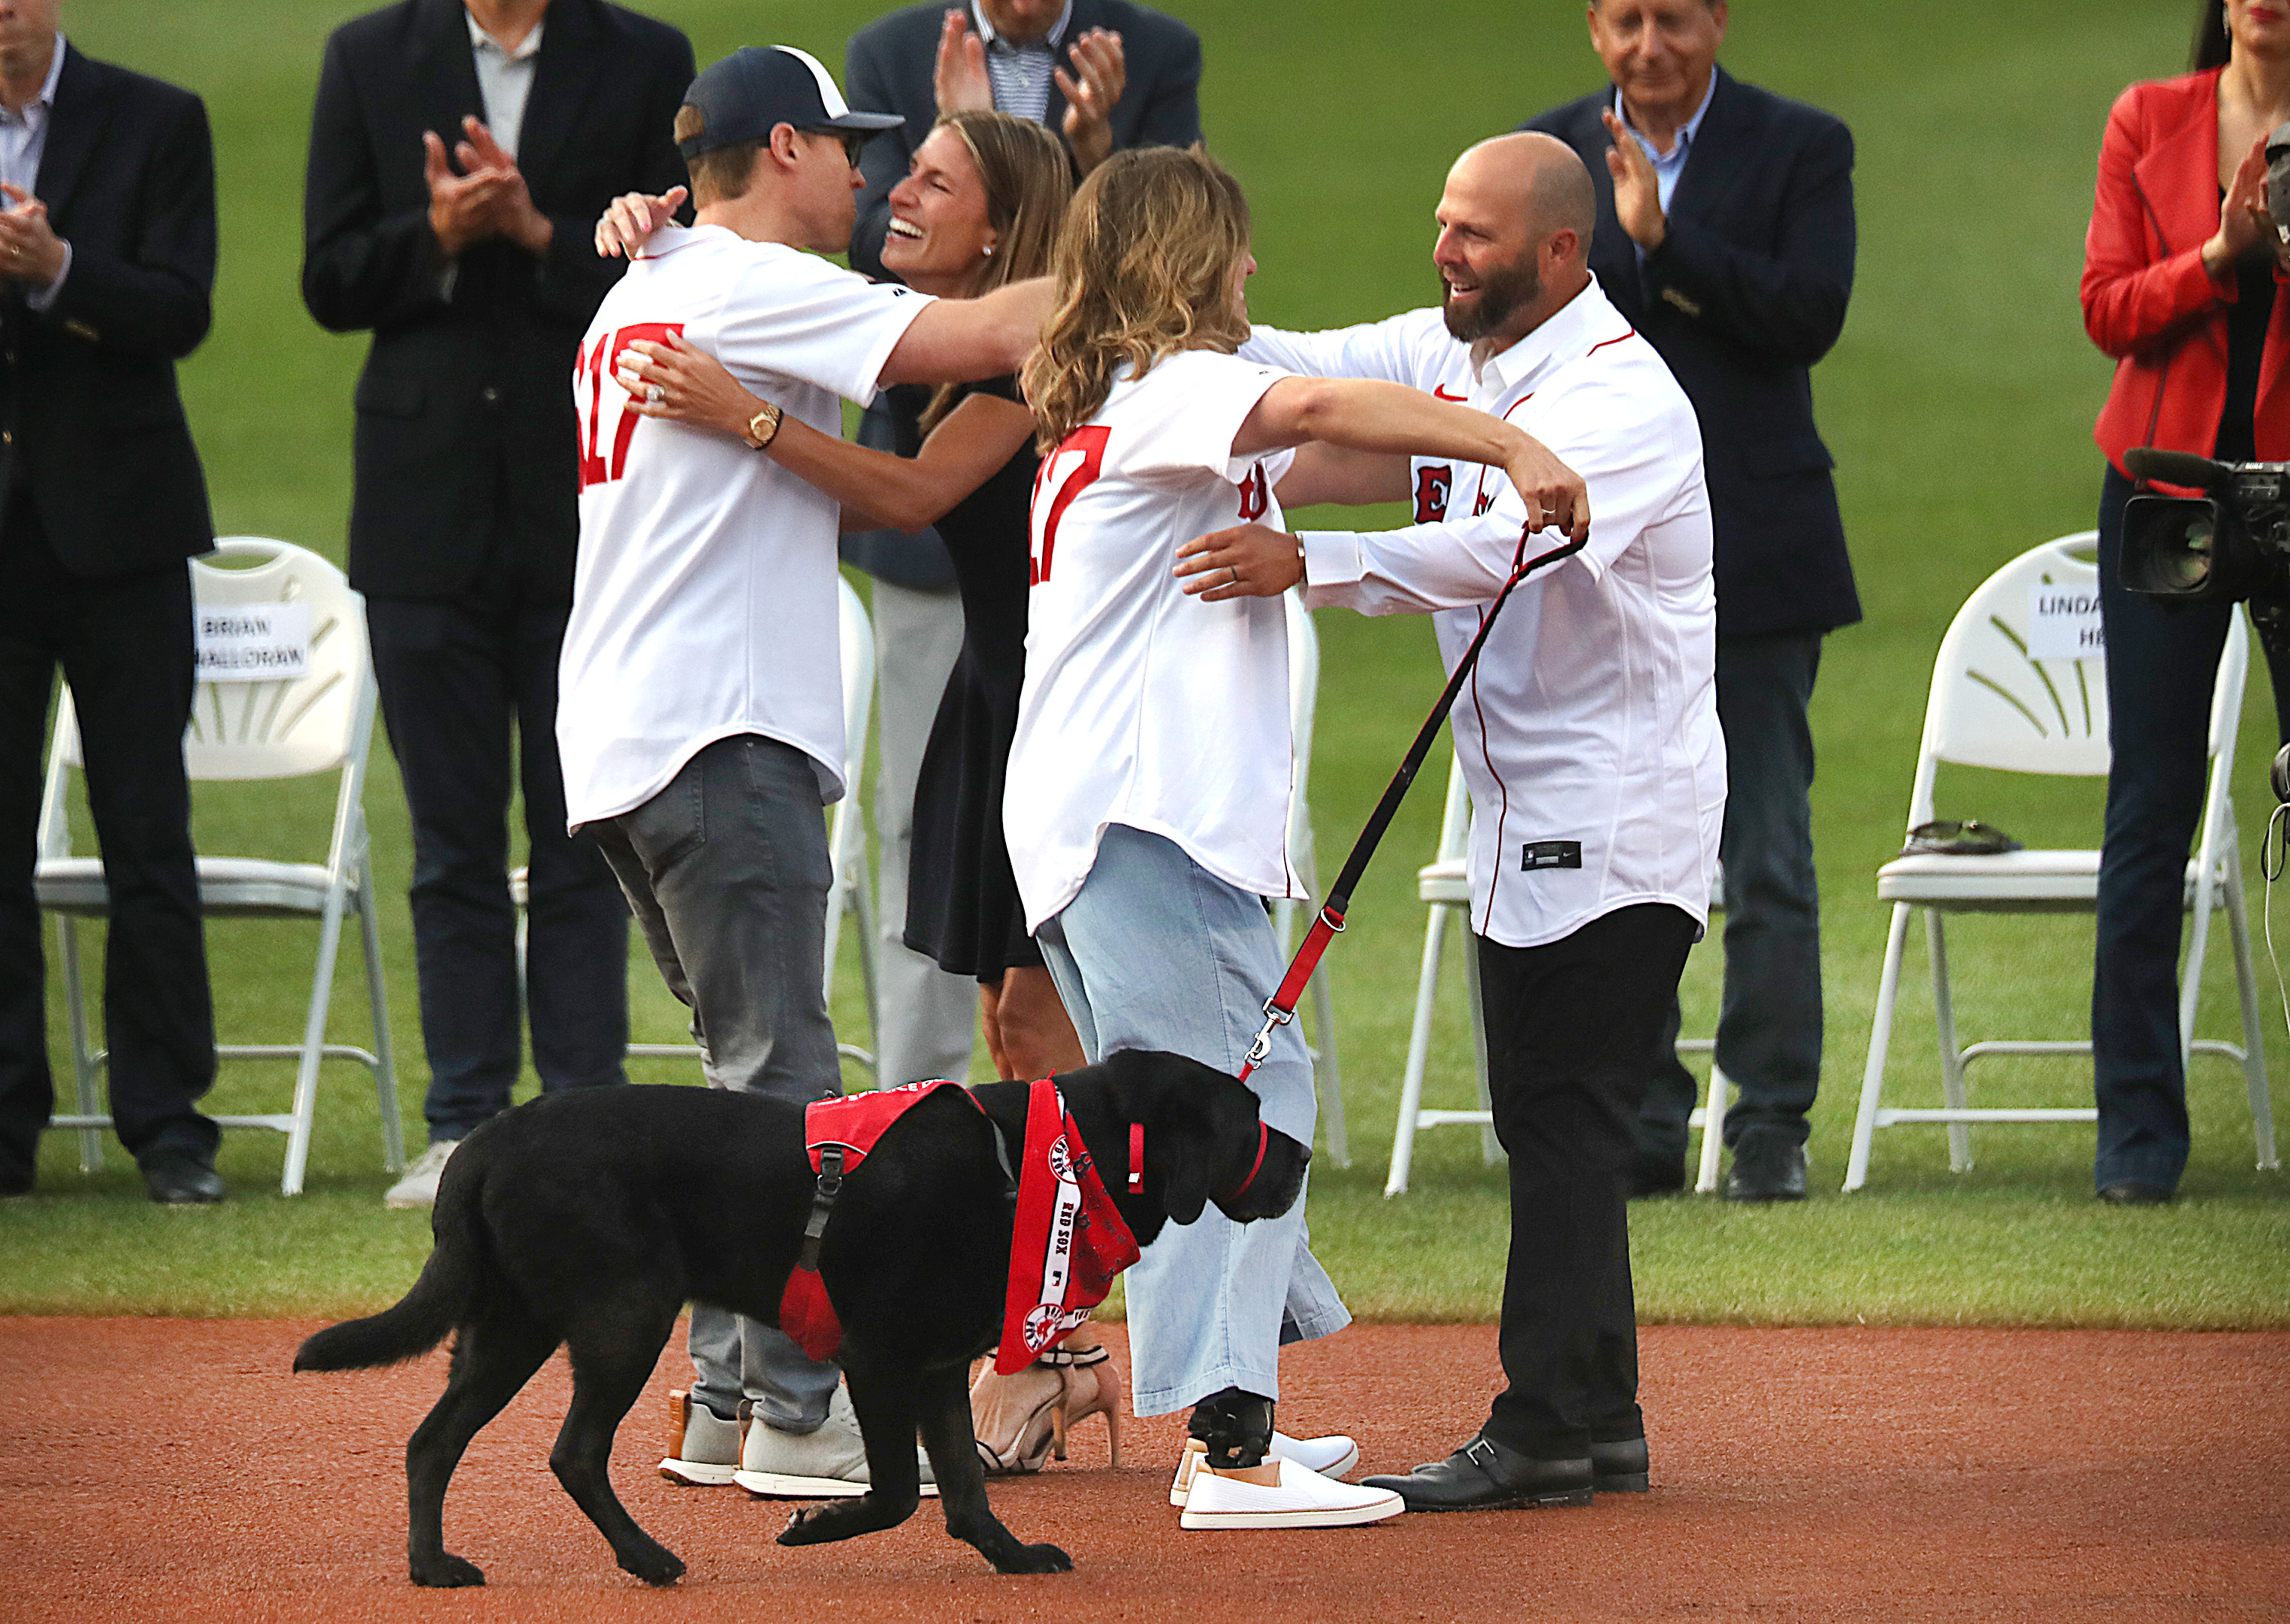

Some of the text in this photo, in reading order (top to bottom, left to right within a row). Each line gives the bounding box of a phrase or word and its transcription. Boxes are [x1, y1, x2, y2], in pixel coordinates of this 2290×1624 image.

[204, 617, 270, 637] BRIAN
[2080, 629, 2104, 646] HE
[1056, 1202, 1074, 1255] RED SOX
